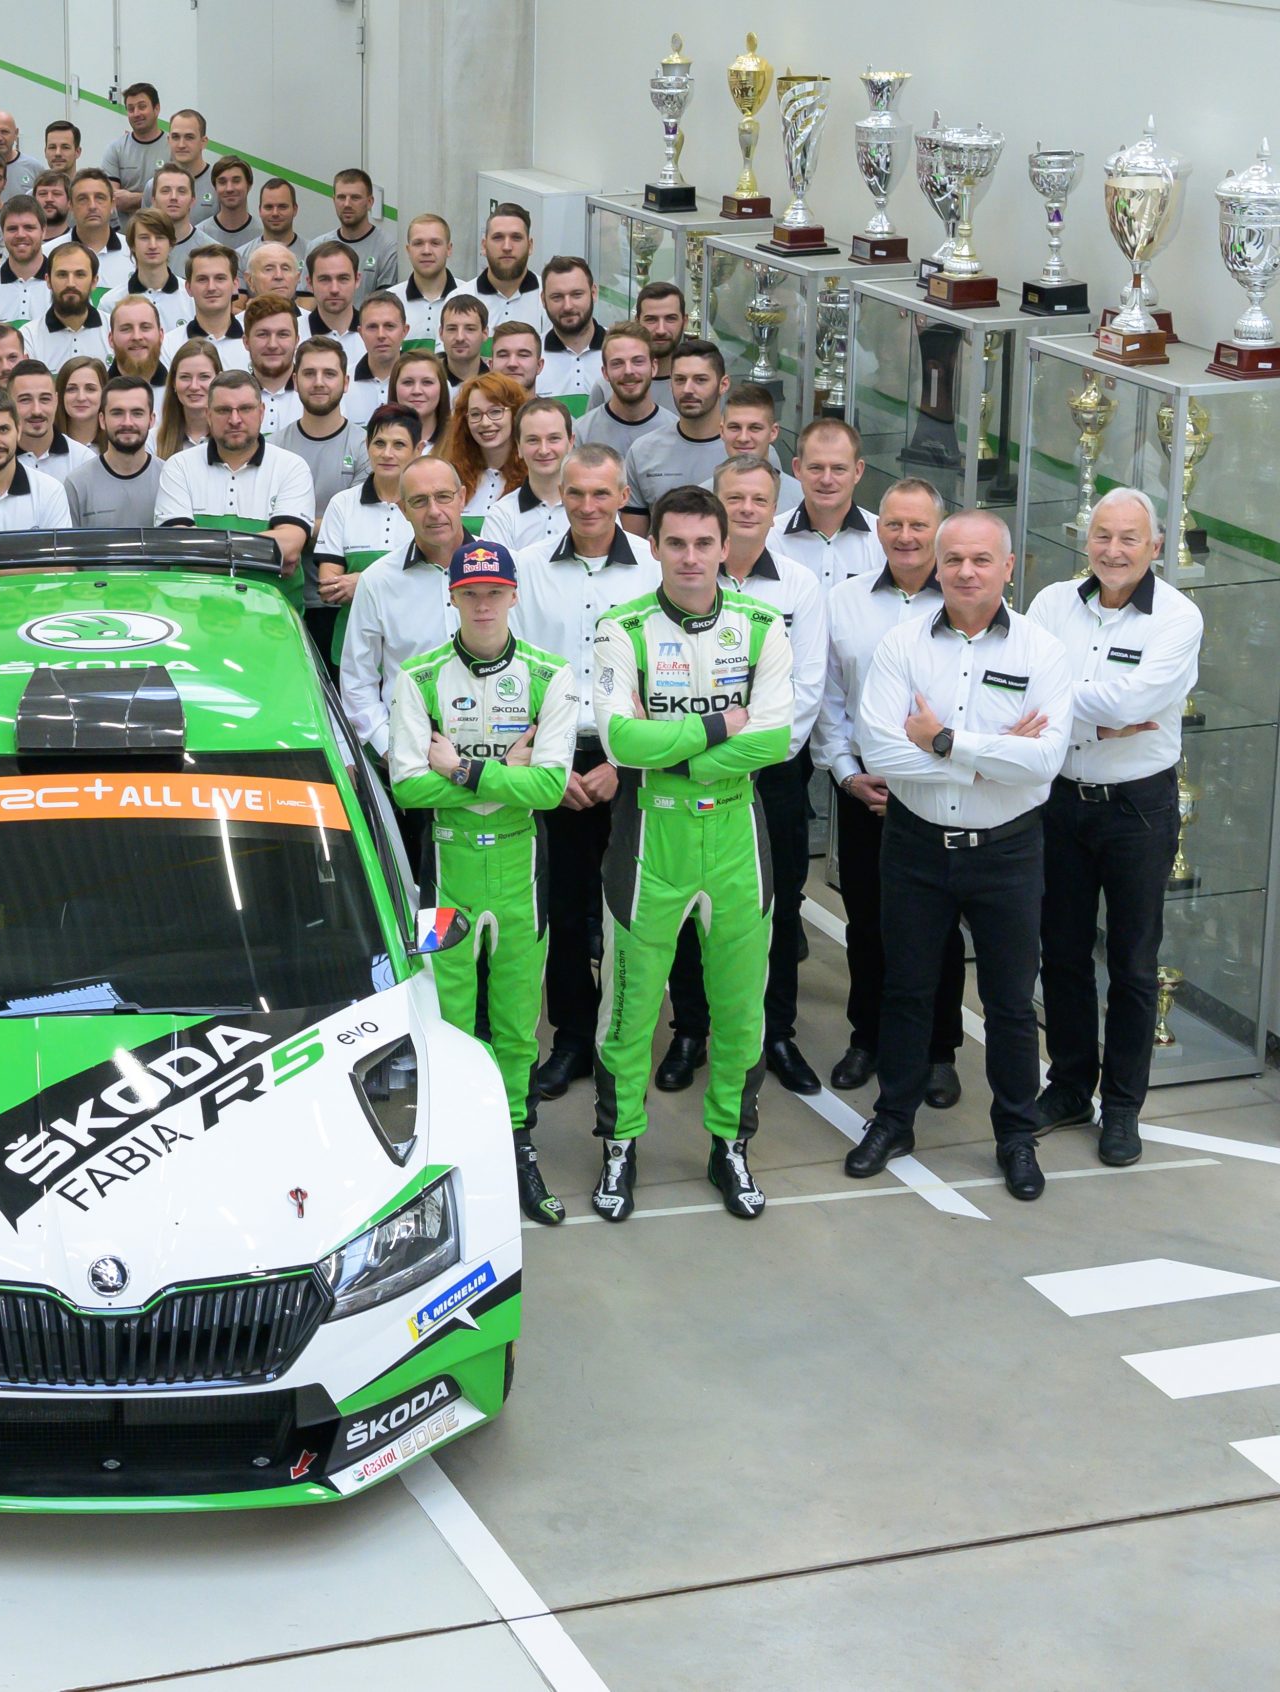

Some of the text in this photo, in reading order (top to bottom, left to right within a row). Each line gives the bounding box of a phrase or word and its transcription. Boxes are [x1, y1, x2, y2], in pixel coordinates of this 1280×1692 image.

[463, 561, 500, 573] Red Bull
[752, 613, 773, 623] OMP
[478, 660, 508, 674] ŠKODA
[715, 656, 749, 666] ŠKODA
[649, 692, 743, 714] ŠKODA
[120, 789, 184, 808] ALL
[191, 789, 264, 811] LIVE
[654, 799, 675, 807] OMP
[4, 1024, 272, 1185] ŠKODA
[56, 1021, 380, 1211] FABIA R5 evo
[432, 1272, 487, 1319] MICHELIN
[346, 1381, 449, 1450] ŠKODA
[363, 1405, 460, 1478] Castrol EDGE
